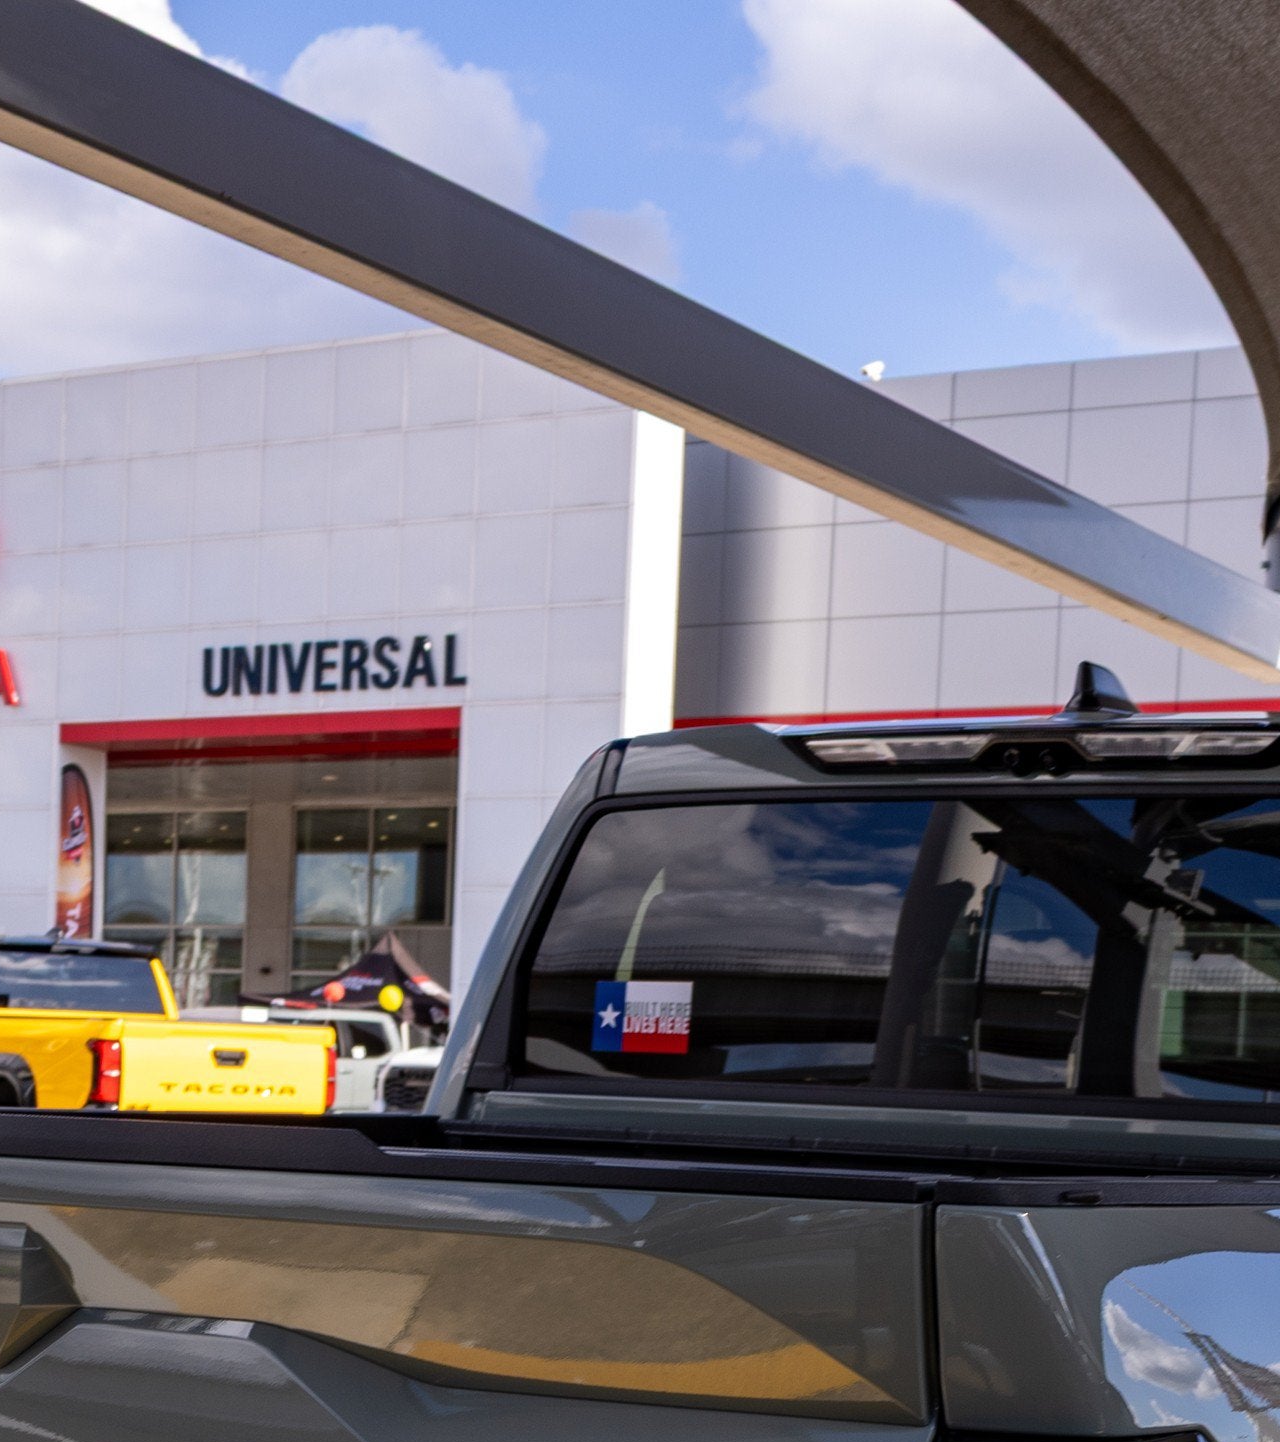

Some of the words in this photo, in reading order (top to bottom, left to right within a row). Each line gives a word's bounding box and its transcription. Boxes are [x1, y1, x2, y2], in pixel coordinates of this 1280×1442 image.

[203, 634, 468, 697] UNIVERSAL
[659, 1002, 692, 1017] HERE
[622, 1016, 658, 1034] LIVES
[657, 1017, 691, 1035] HERE
[159, 1082, 297, 1096] TACOMA
